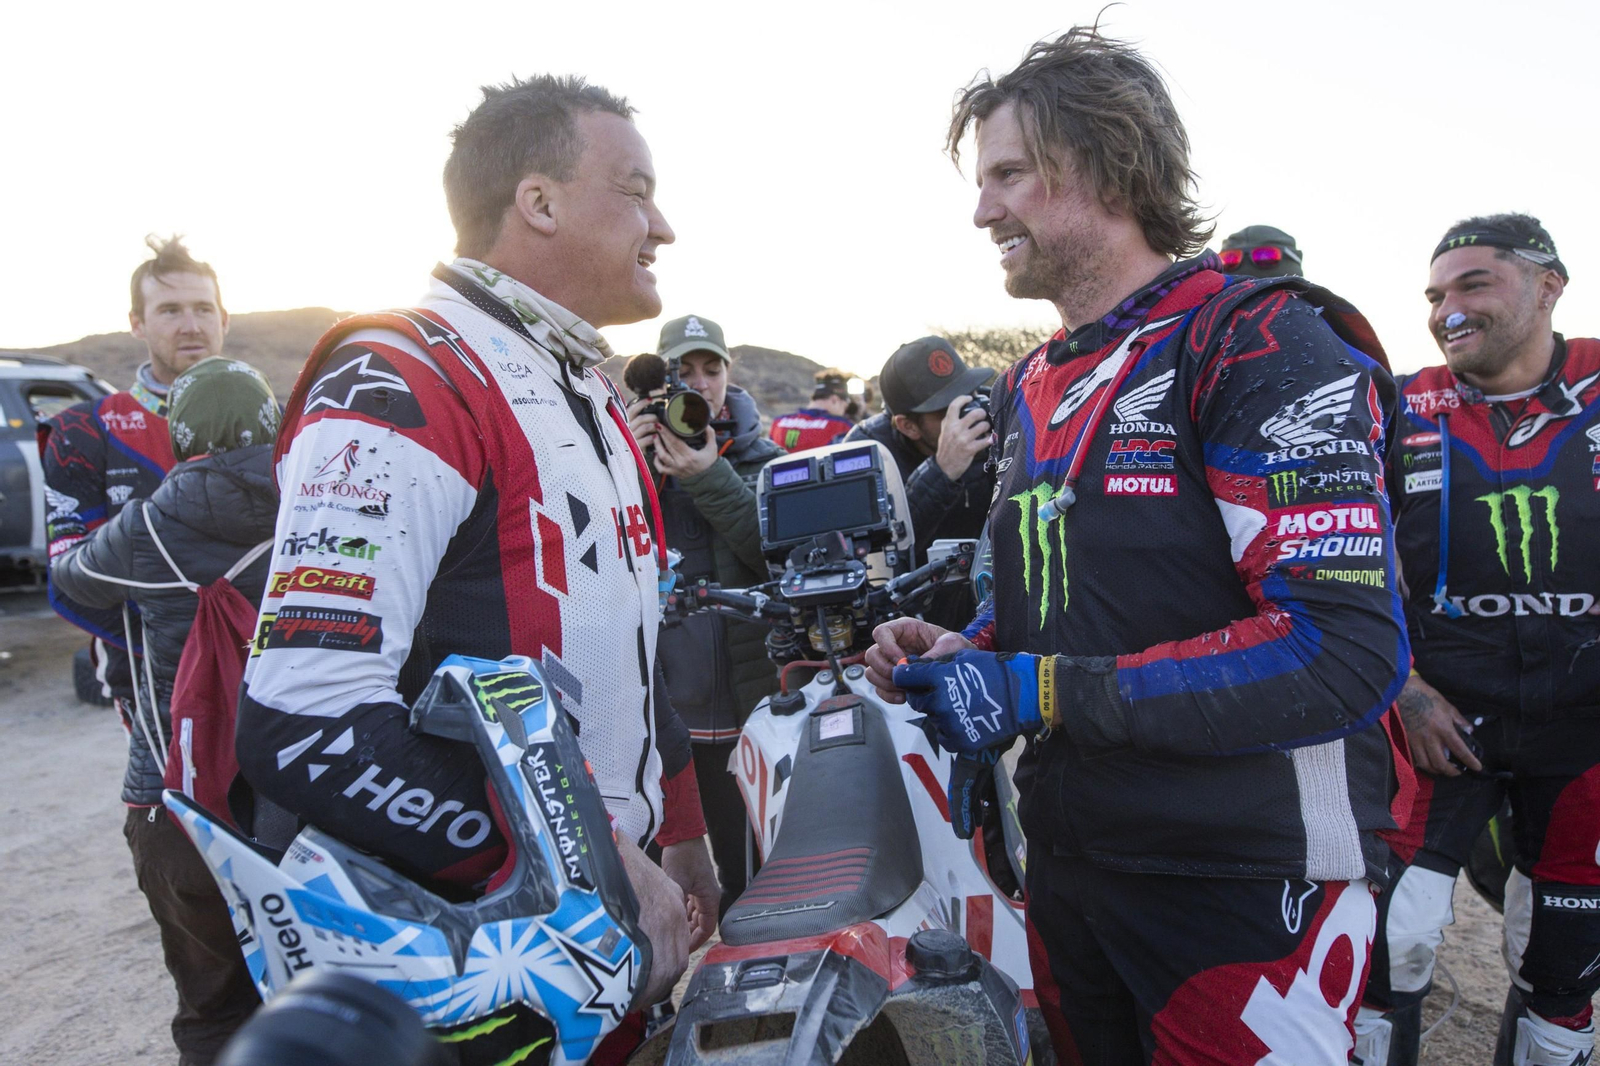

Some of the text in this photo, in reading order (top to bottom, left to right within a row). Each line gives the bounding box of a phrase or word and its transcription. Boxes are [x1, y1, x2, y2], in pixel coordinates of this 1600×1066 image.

[1404, 398, 1460, 415] AIRBAG
[1109, 422, 1177, 435] HONDA
[1106, 438, 1176, 464] HRC
[1265, 440, 1370, 465] HONDA
[297, 480, 386, 502] MSTRONGS
[1107, 477, 1174, 493] MOTUL
[1313, 484, 1364, 494] ENERG
[1277, 508, 1378, 536] MOTUL
[1277, 537, 1383, 560] SHOWA
[279, 611, 301, 619] AULO
[1043, 690, 1050, 700] 30
[1043, 701, 1050, 711] 60
[944, 676, 981, 743] ASTARS
[341, 764, 491, 848] Hero
[527, 747, 581, 879] MONSTER
[555, 764, 588, 853] ENERGY
[1542, 895, 1600, 909] HON
[260, 893, 315, 971] Hero
